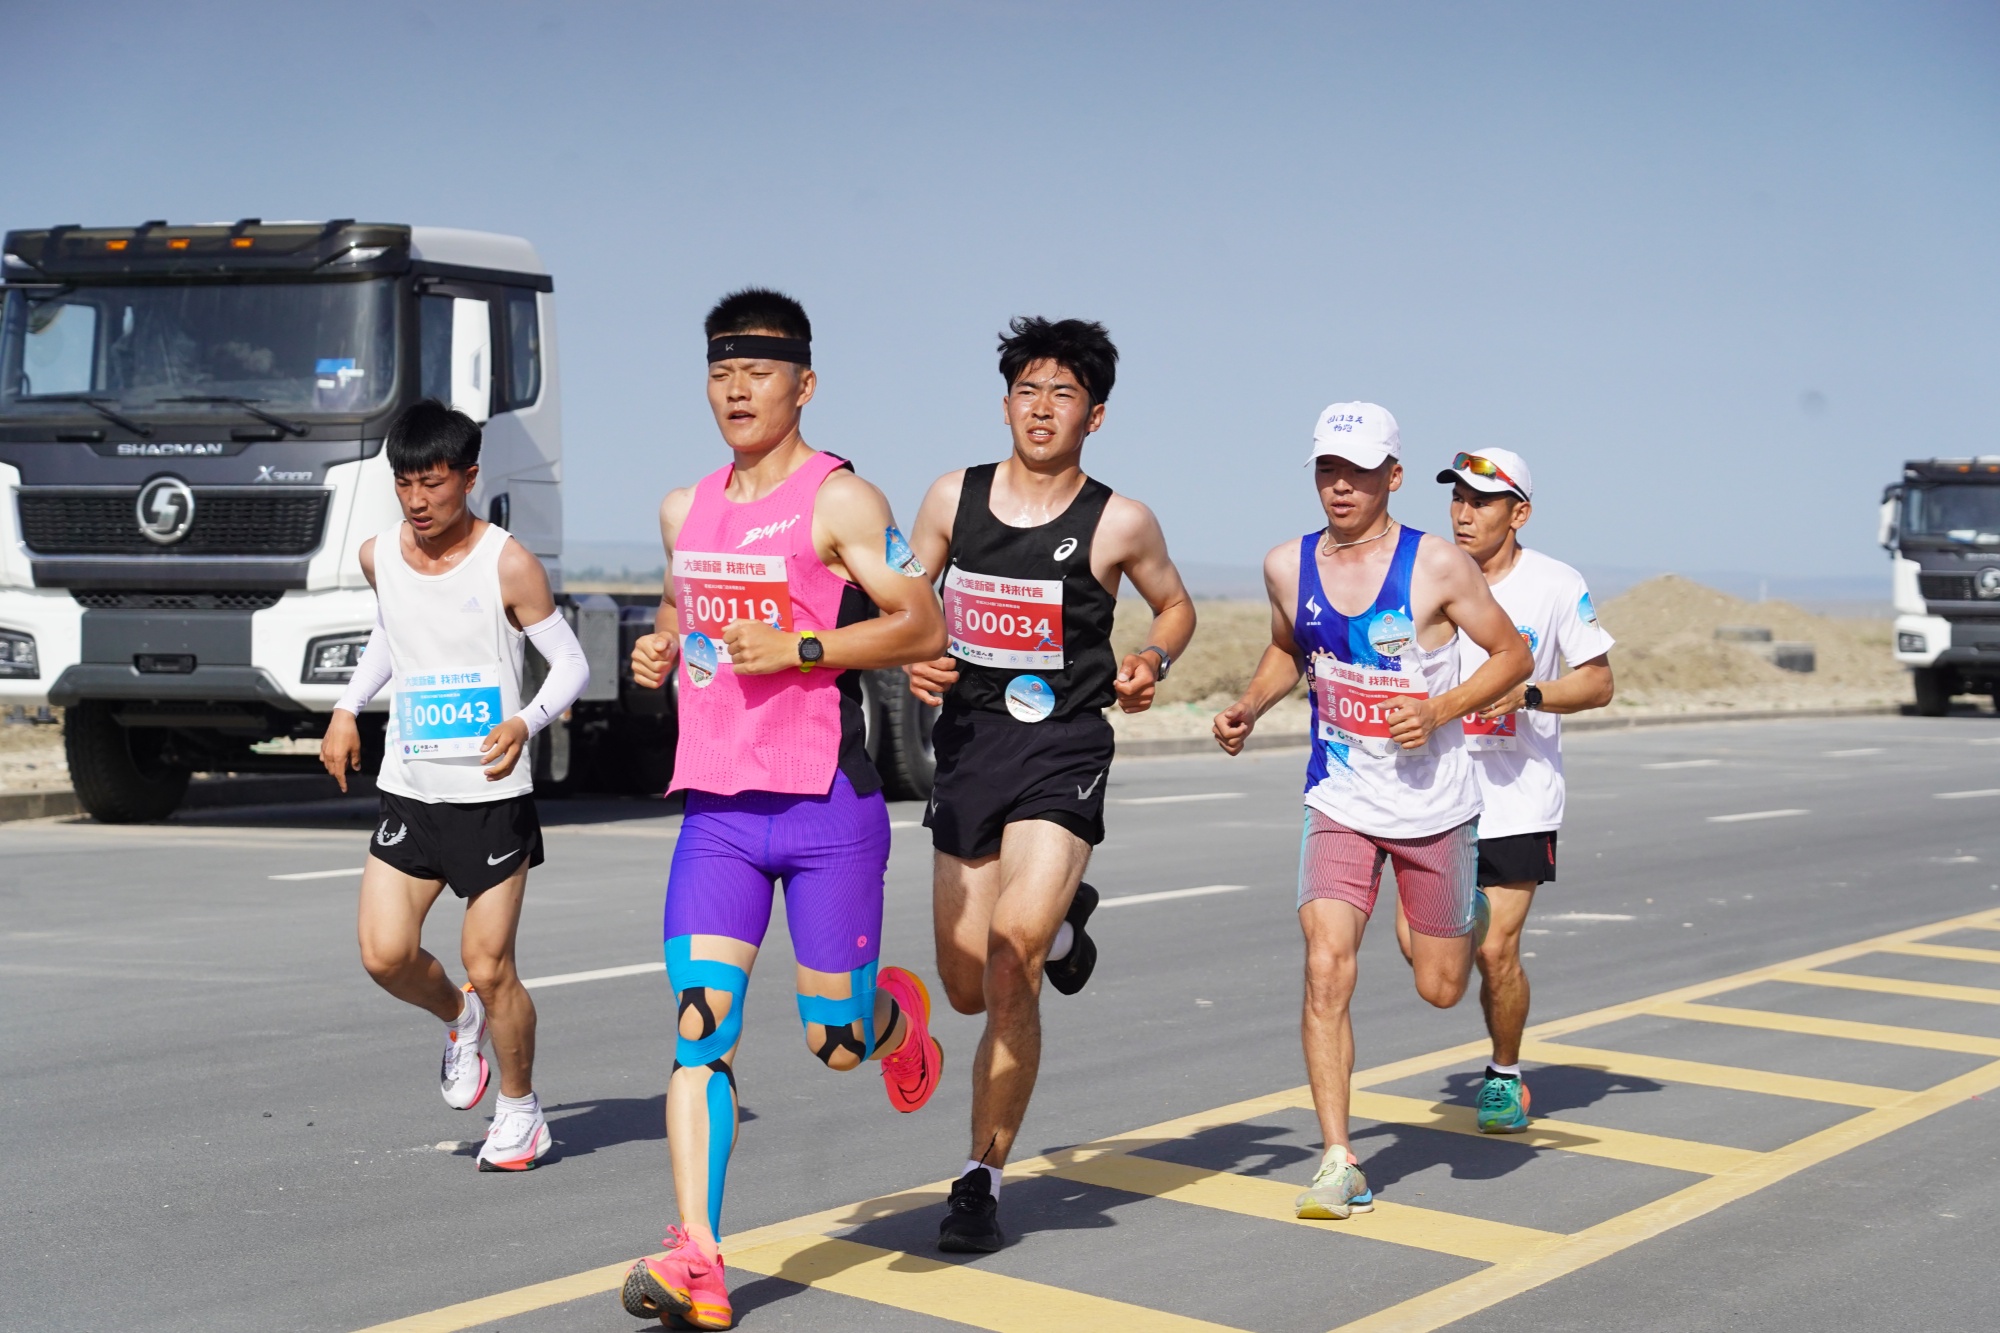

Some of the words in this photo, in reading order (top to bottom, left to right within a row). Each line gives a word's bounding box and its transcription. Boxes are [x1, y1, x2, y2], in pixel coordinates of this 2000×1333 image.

[117, 443, 223, 456] SHACMAN
[684, 559, 722, 573] 大美新疆
[726, 561, 767, 576] 我来代言
[956, 576, 996, 592] 大美新疆
[1000, 583, 1044, 598] 我来代言
[696, 595, 779, 624] 00119
[966, 609, 1053, 638] 00034
[440, 672, 482, 685] 我来代言
[1330, 666, 1364, 684] 大美新疆
[1369, 676, 1410, 688] 我来代言
[414, 701, 491, 726] 00043
